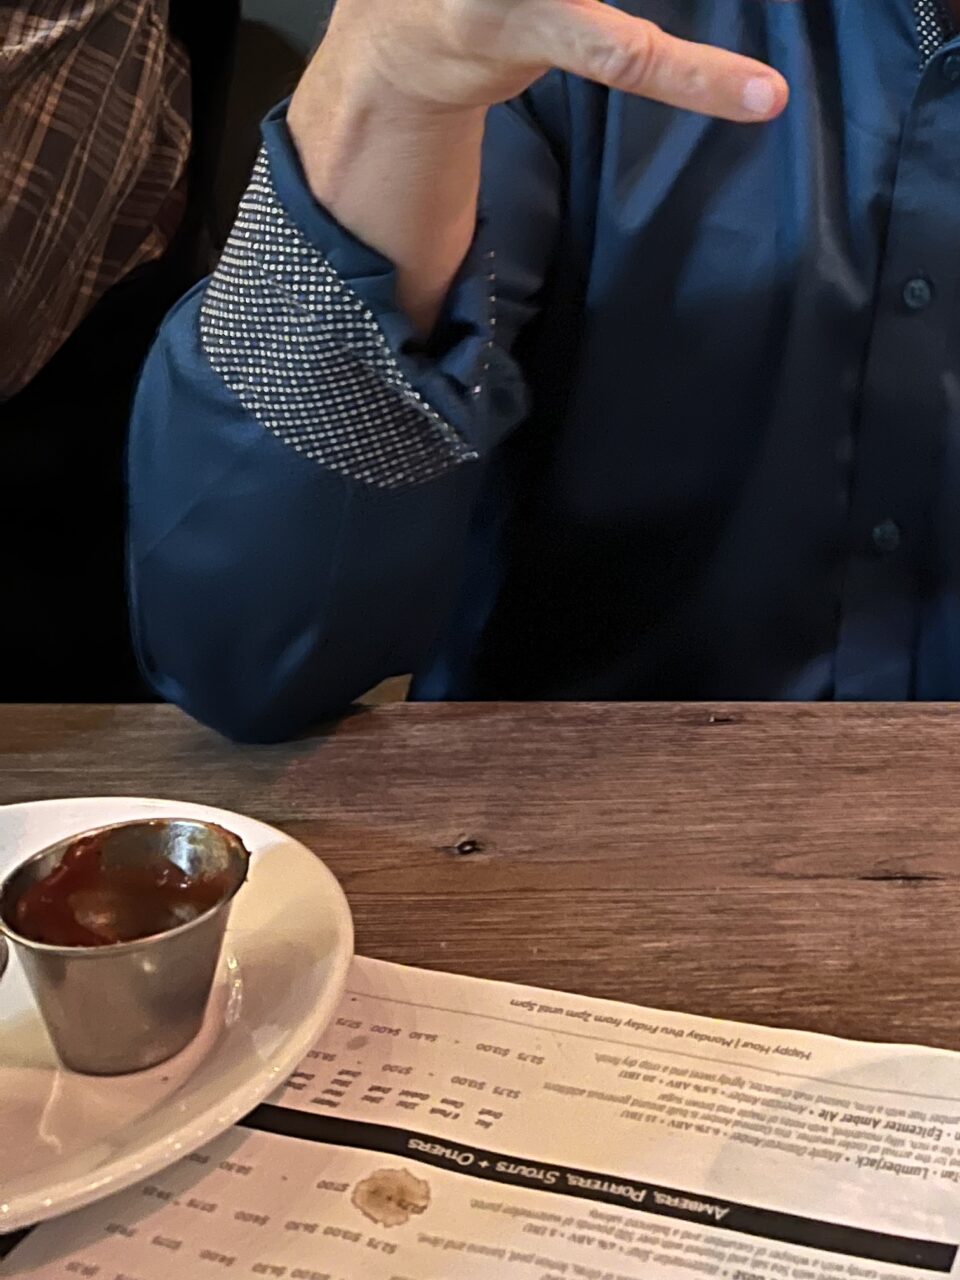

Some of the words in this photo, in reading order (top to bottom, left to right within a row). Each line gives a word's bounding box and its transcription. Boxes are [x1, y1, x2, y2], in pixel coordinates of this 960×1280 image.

[509, 998, 538, 1011] 5pm
[536, 1004, 564, 1014] until
[564, 1009, 592, 1022] 2pm
[593, 1014, 622, 1027] from
[369, 1024, 402, 1036] $4.00
[623, 1018, 659, 1034] Friday
[659, 1026, 684, 1038] thru
[685, 1029, 734, 1047] Monday
[475, 1043, 510, 1057] $13.00
[740, 1041, 771, 1054] Hour
[771, 1045, 812, 1060] Happy
[516, 1052, 545, 1065] $2.75
[491, 1085, 521, 1099] $2.75
[817, 1108, 839, 1122] Ale
[839, 1113, 882, 1129] Amber
[882, 1120, 943, 1141] Epicenter
[407, 1138, 474, 1165] OTHERS
[495, 1161, 560, 1184] STOUTS
[854, 1155, 929, 1179] Lumberjack
[566, 1173, 646, 1202] PORTERS,
[653, 1190, 729, 1220] AMBERS,
